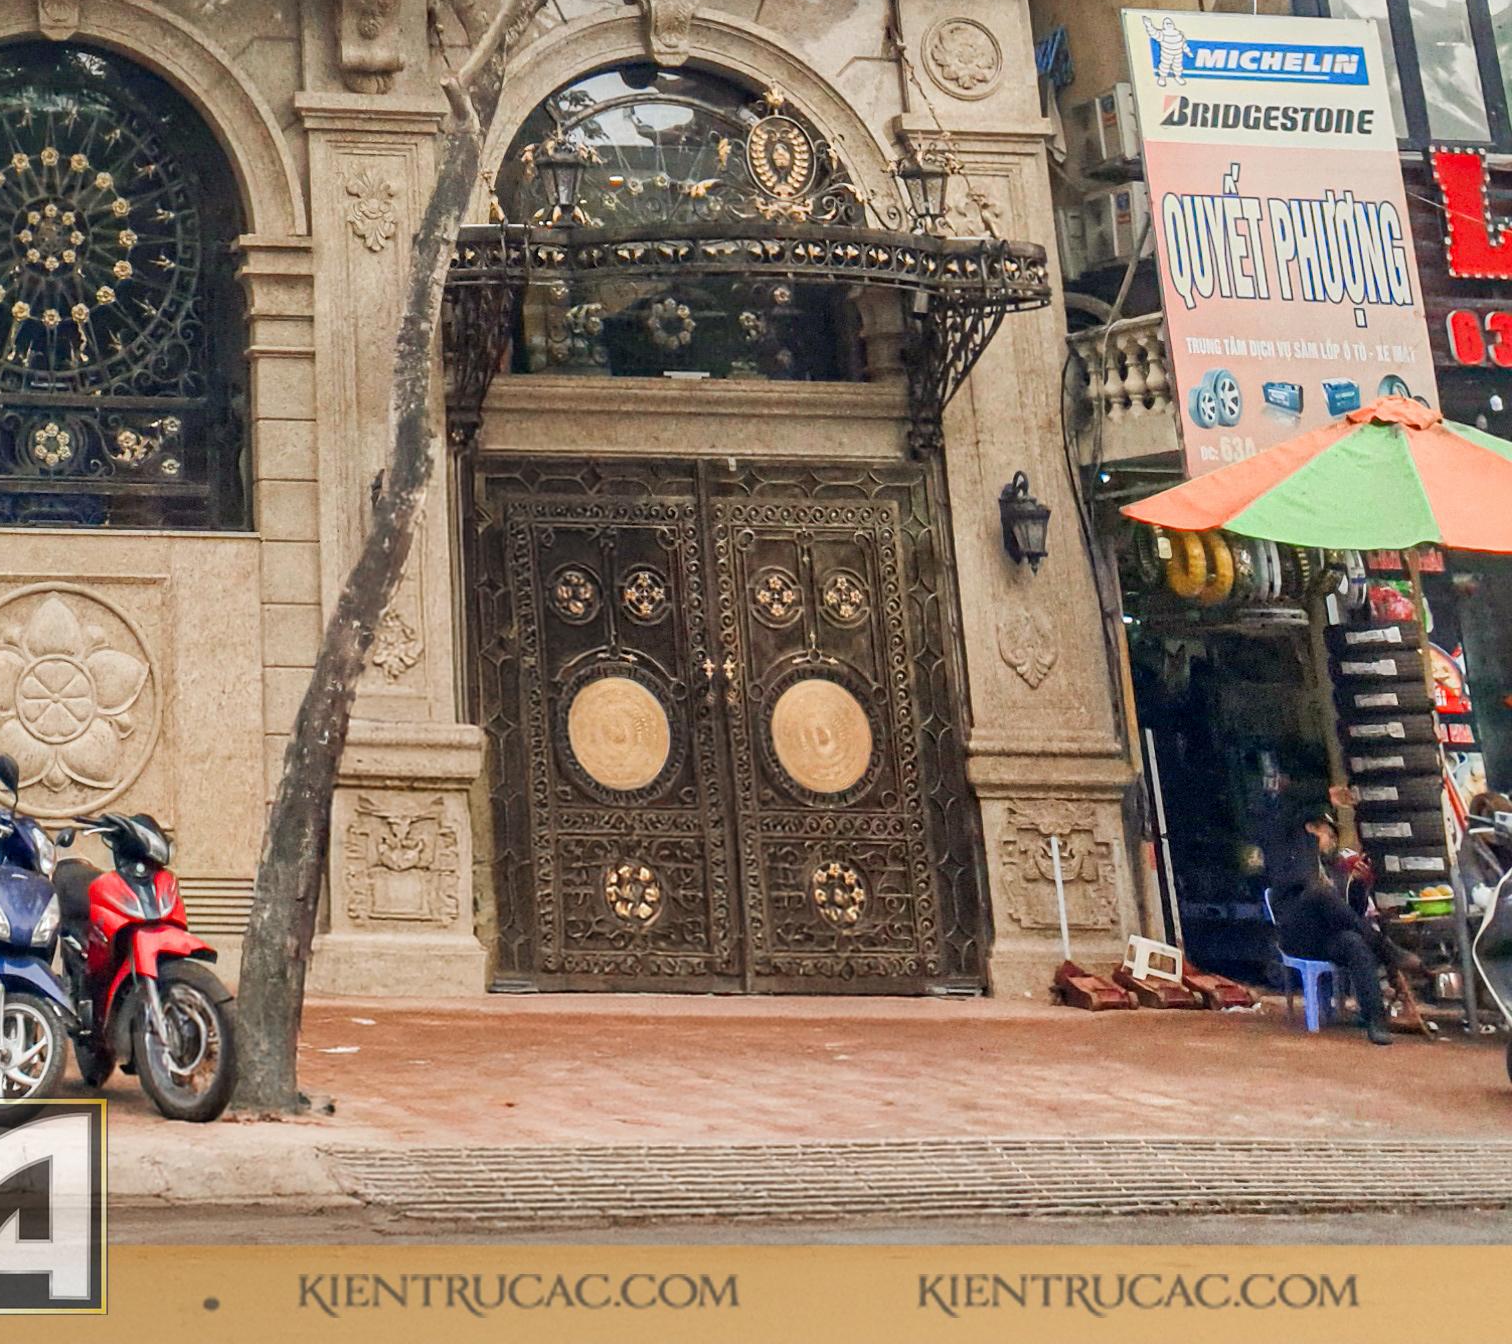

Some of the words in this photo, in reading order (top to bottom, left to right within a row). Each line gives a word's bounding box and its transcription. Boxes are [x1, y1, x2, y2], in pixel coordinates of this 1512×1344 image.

[1194, 48, 1360, 75] MICHELIN
[1160, 95, 1375, 135] BRIDGESTONE
[1162, 163, 1271, 310] QUYẾT
[1267, 188, 1414, 328] PHƯỢNG
[1185, 336, 1222, 355] TRUNG
[1223, 335, 1248, 357] TÂM
